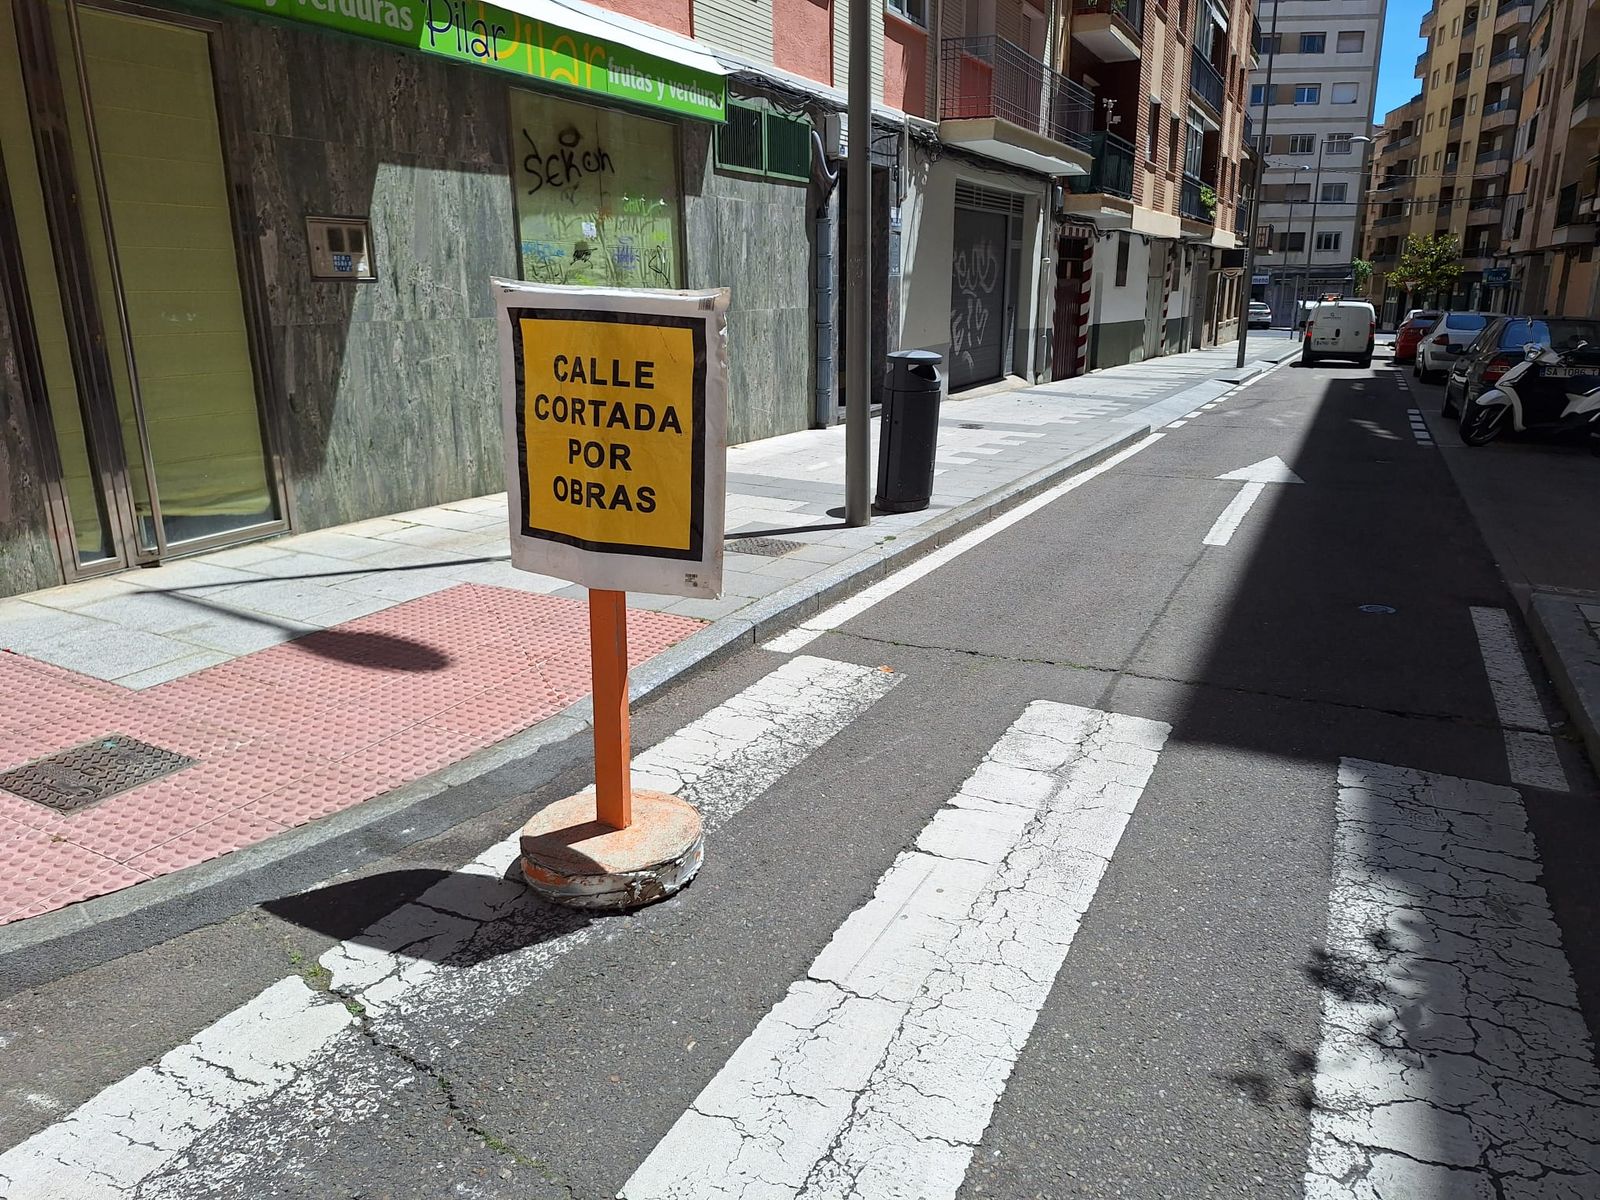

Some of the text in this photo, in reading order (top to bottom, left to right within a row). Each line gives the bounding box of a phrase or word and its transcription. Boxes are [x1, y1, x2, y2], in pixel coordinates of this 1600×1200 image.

[421, 0, 505, 61] Pilar
[608, 57, 723, 110] frutas y verduras
[553, 354, 655, 390] CALLE
[534, 393, 683, 434] CORTADA
[568, 438, 633, 471] POR
[553, 475, 657, 513] OBRAS
